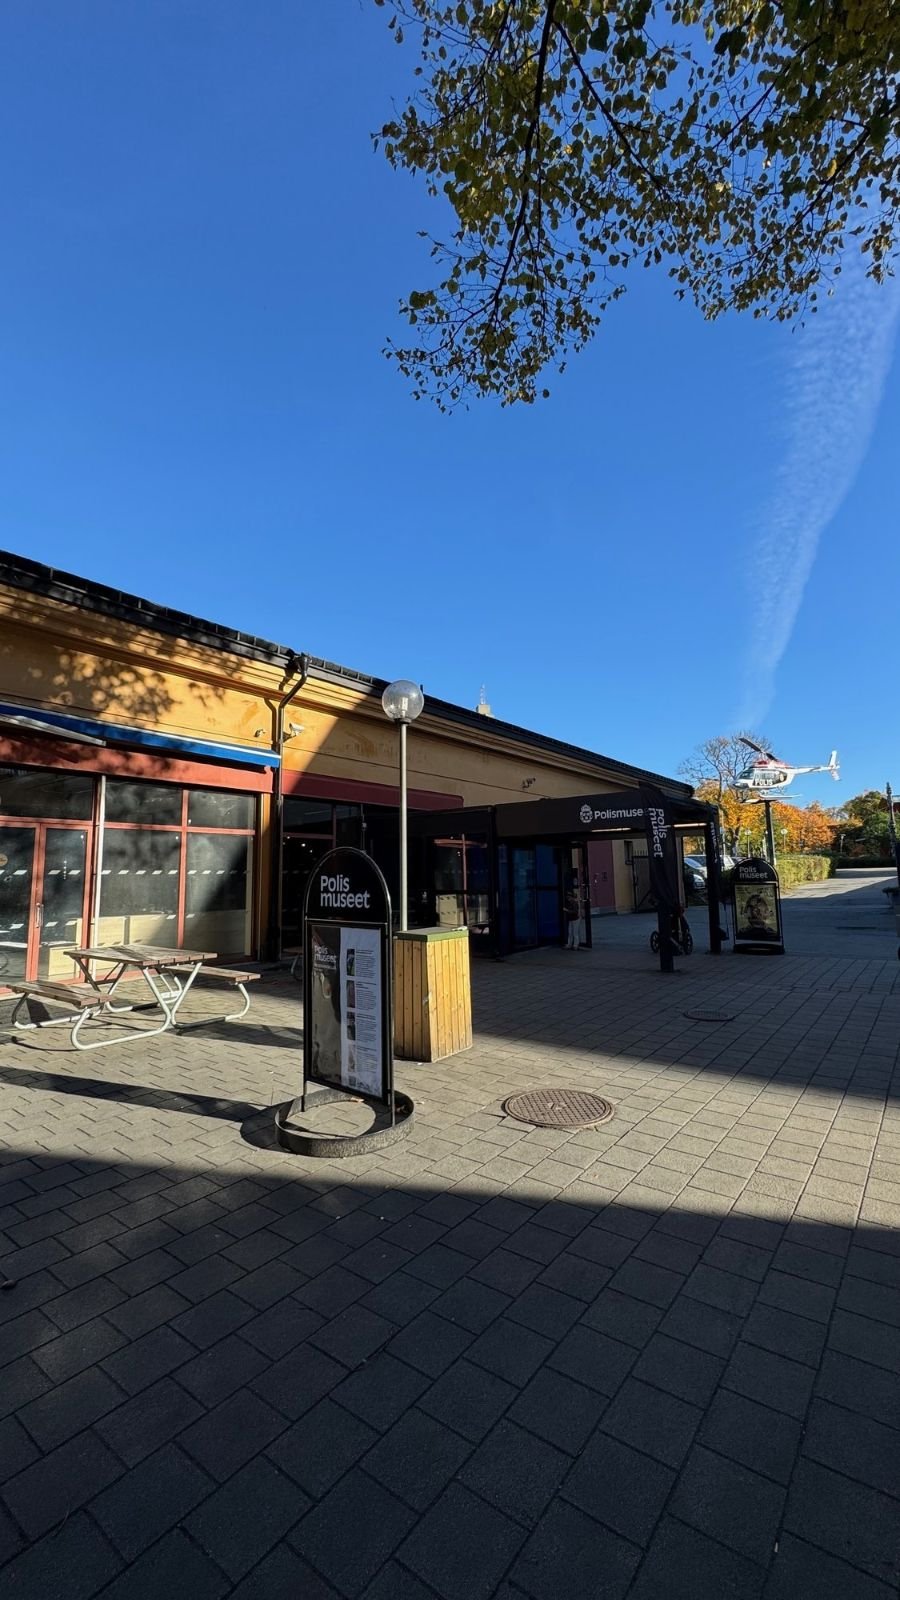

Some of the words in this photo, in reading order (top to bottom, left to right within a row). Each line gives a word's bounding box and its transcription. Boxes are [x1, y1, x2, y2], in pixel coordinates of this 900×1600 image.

[594, 808, 644, 820] Polismuse
[320, 874, 350, 892] Polis
[320, 889, 371, 909] museet
